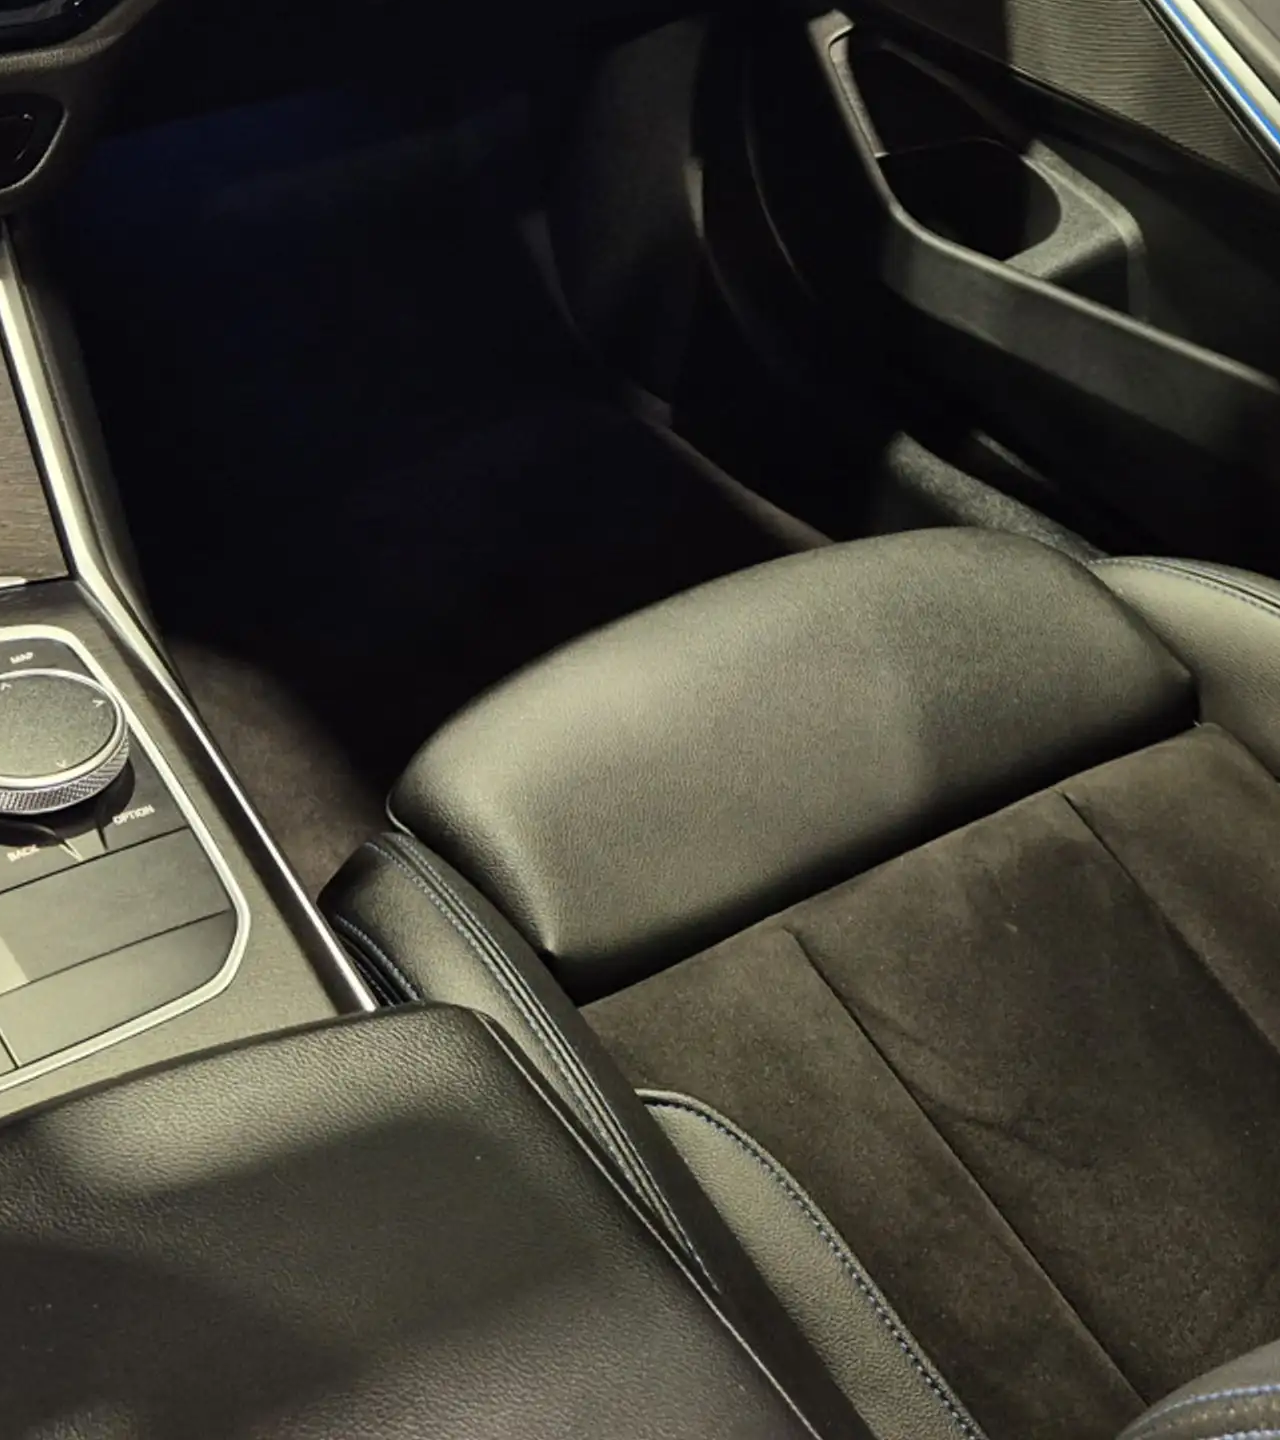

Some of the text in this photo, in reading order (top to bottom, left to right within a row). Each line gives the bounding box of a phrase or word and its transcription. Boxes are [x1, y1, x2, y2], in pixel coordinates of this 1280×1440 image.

[10, 651, 34, 664] MAP
[111, 804, 156, 825] OPTION
[6, 844, 40, 862] BACK
